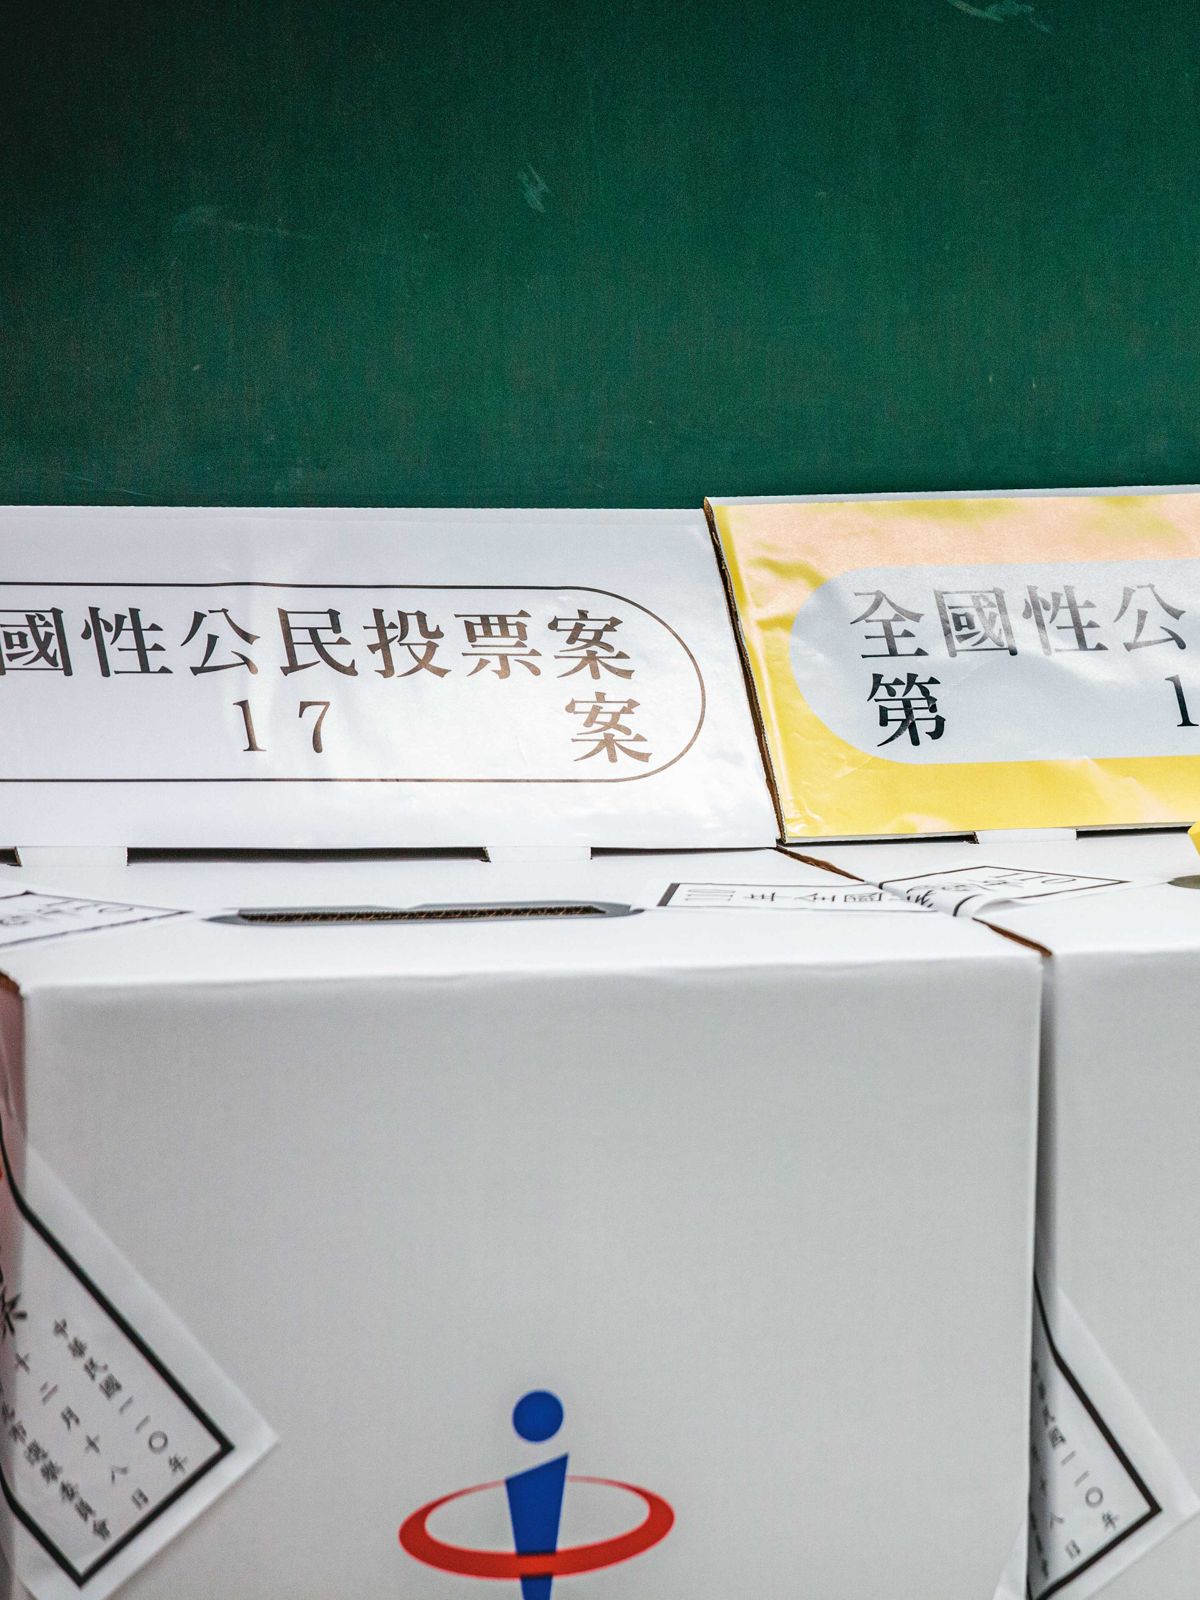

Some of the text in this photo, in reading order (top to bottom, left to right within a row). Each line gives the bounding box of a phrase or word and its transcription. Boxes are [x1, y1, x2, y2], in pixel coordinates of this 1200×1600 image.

[0, 606, 636, 680] 國性公民投票案
[233, 692, 652, 764] 17 案
[866, 672, 947, 748] 第
